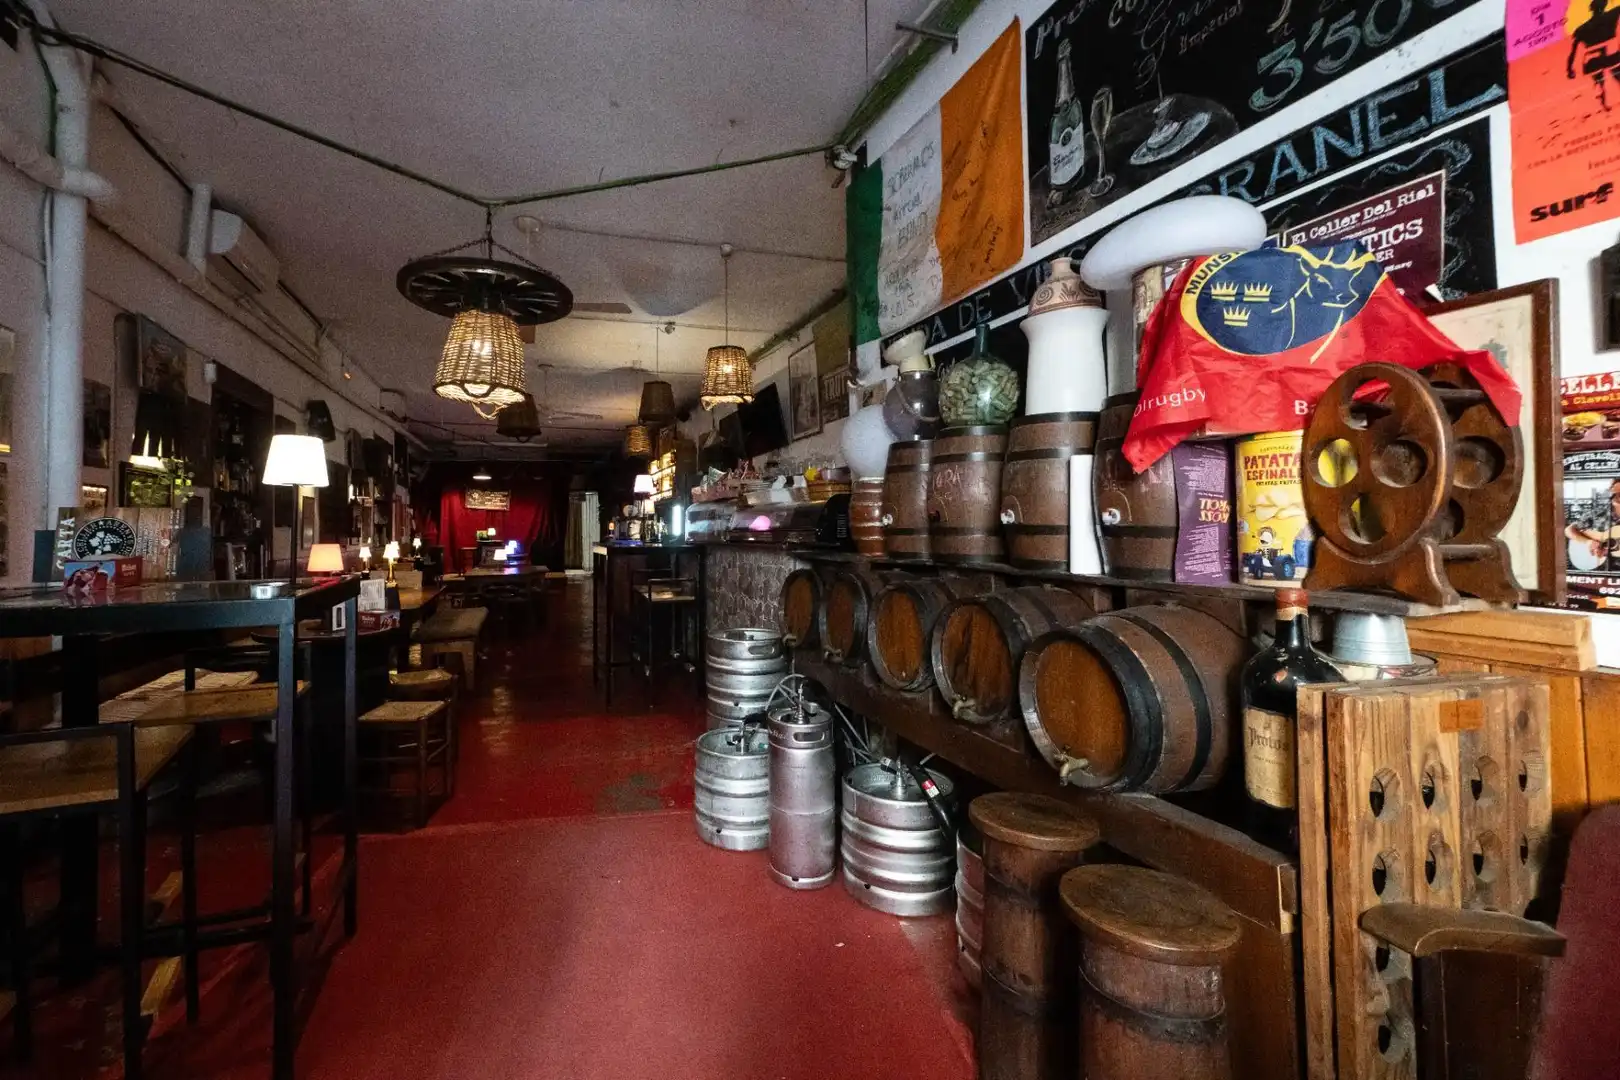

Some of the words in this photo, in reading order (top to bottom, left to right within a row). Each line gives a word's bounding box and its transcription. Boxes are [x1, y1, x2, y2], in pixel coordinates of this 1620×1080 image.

[1530, 181, 1614, 223] surf
[1291, 234, 1308, 247] El
[1309, 212, 1360, 240] Celler
[1185, 251, 1241, 295] MUNS
[56, 516, 76, 570] CARTA
